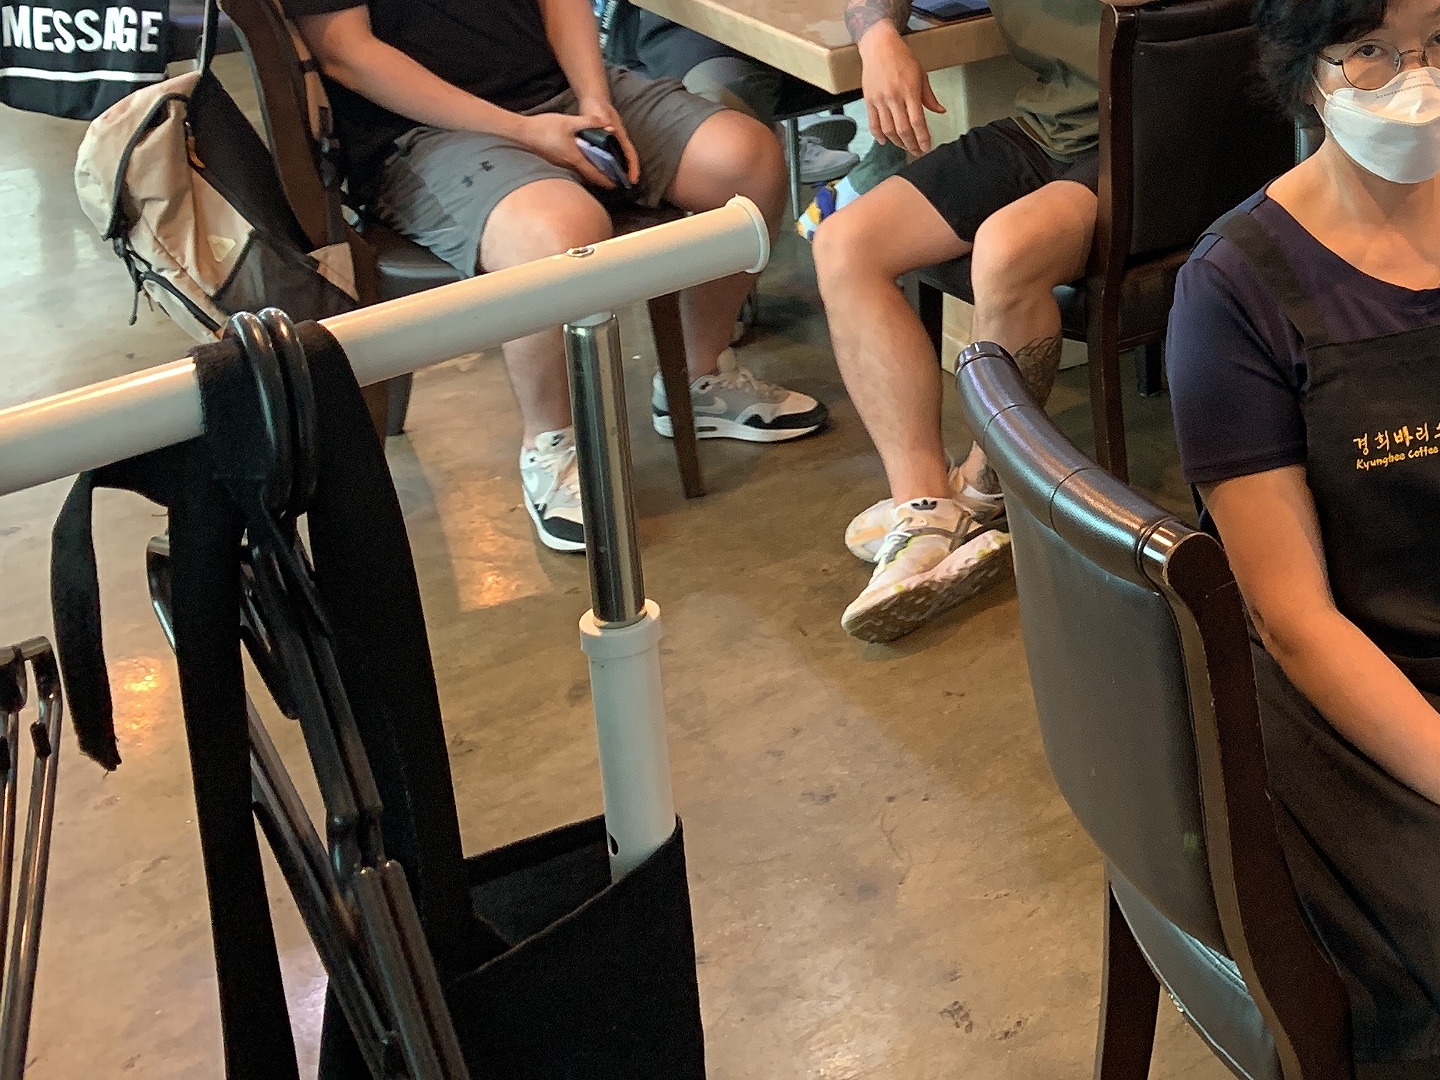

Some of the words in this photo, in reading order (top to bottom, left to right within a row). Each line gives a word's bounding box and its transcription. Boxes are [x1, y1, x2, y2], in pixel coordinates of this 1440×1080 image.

[2, 5, 163, 54] MESSAGE
[1356, 452, 1405, 471] Kyunghee
[1408, 446, 1438, 459] Coffee
